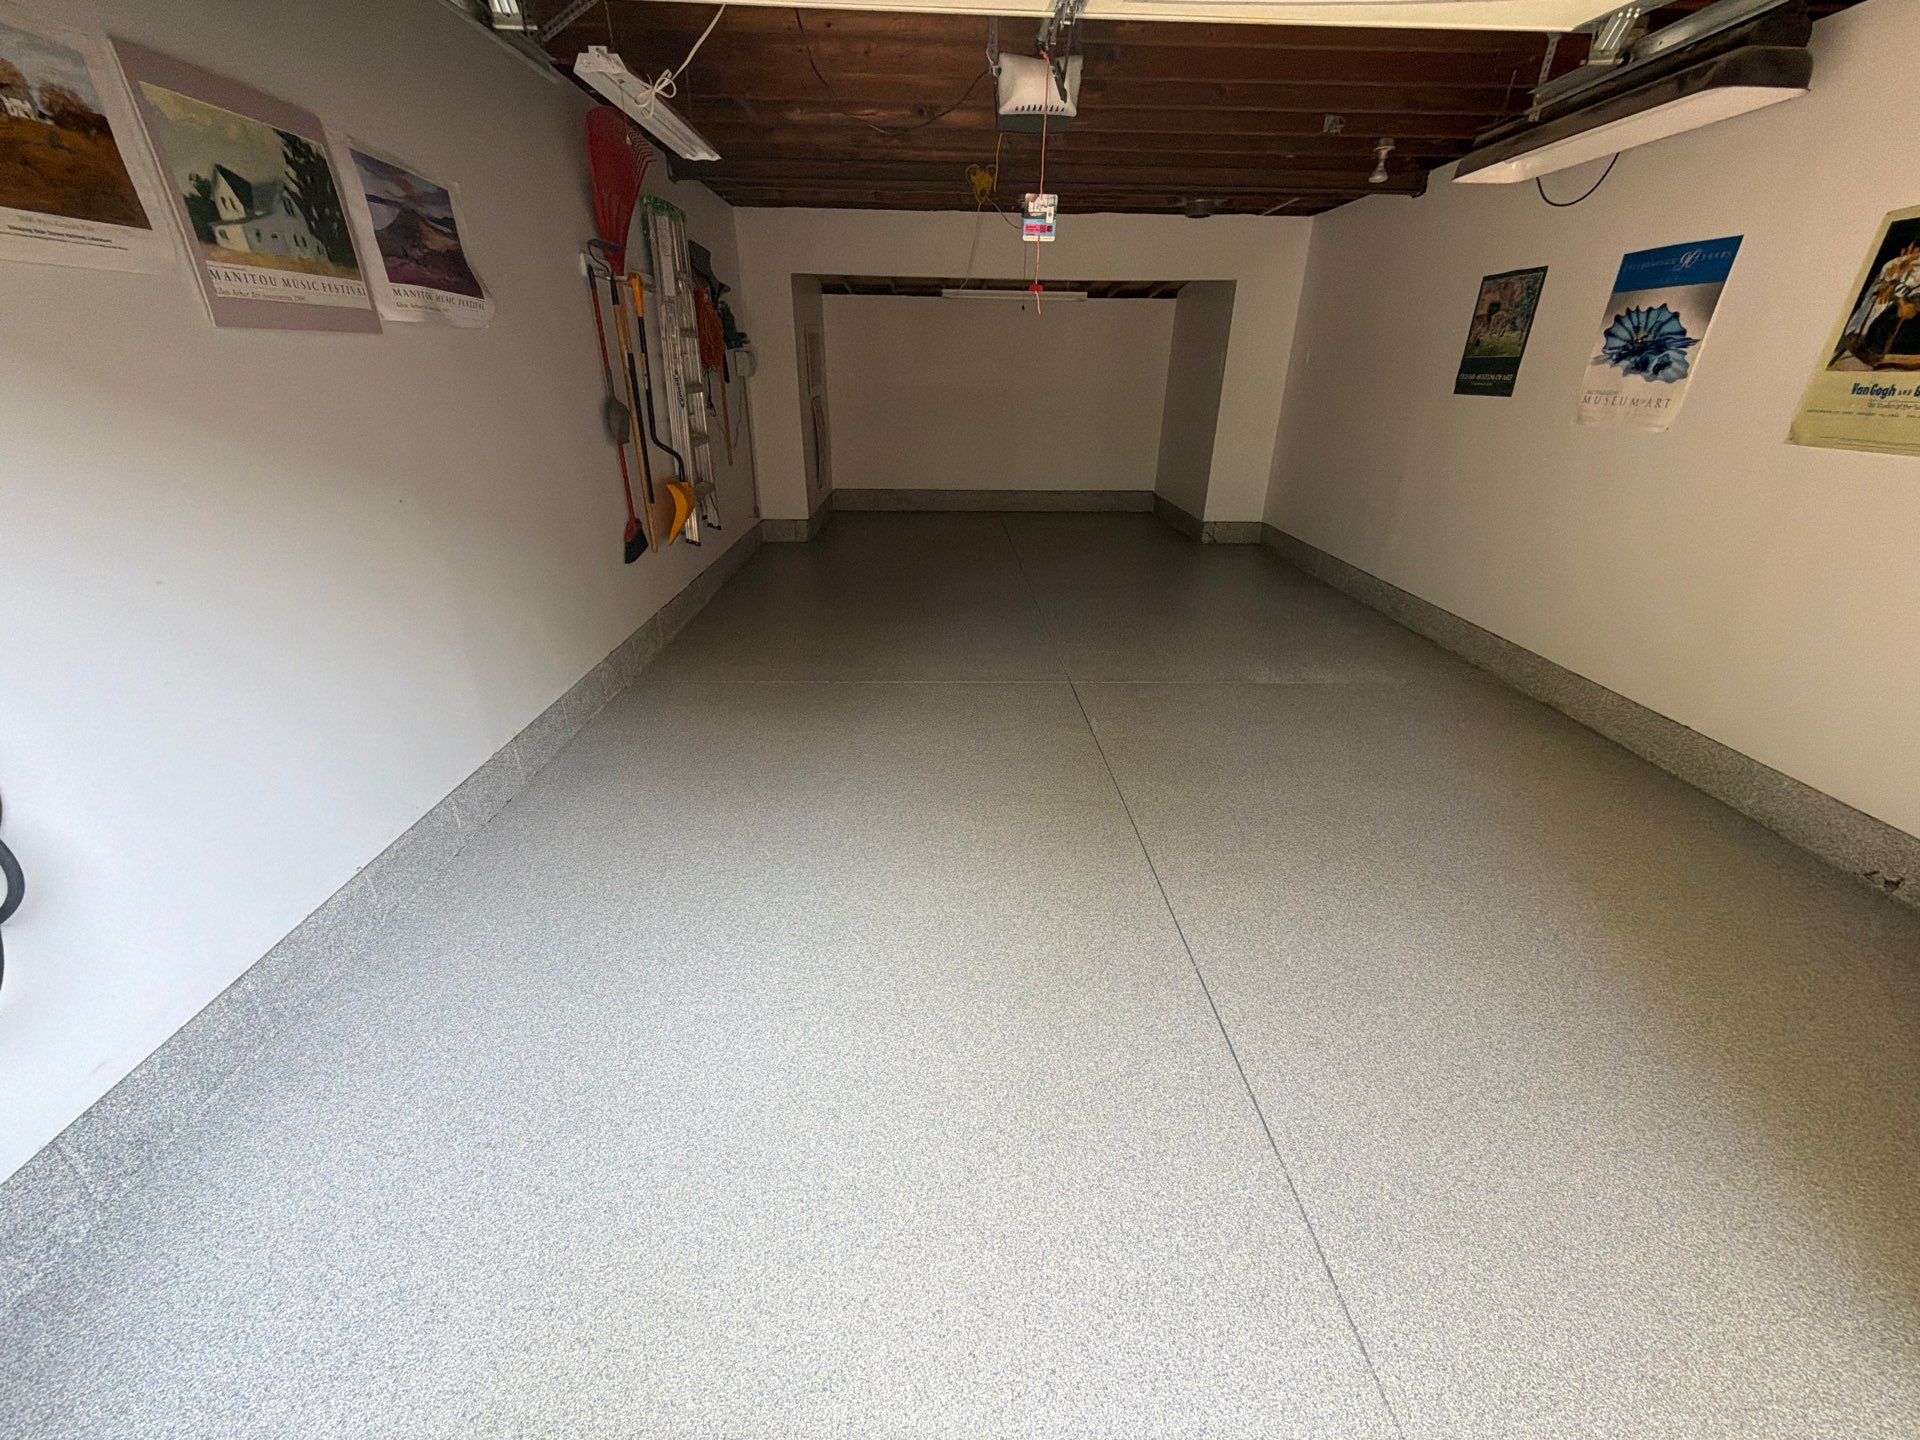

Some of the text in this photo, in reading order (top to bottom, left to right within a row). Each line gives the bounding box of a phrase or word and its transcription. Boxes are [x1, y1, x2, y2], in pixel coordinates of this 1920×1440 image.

[208, 269, 368, 297] MANITOU MUSIC FESTIVAL
[1851, 382, 1870, 396] Van
[1870, 383, 1897, 400] Gogh
[1582, 395, 1671, 409] MUSEUM ART
